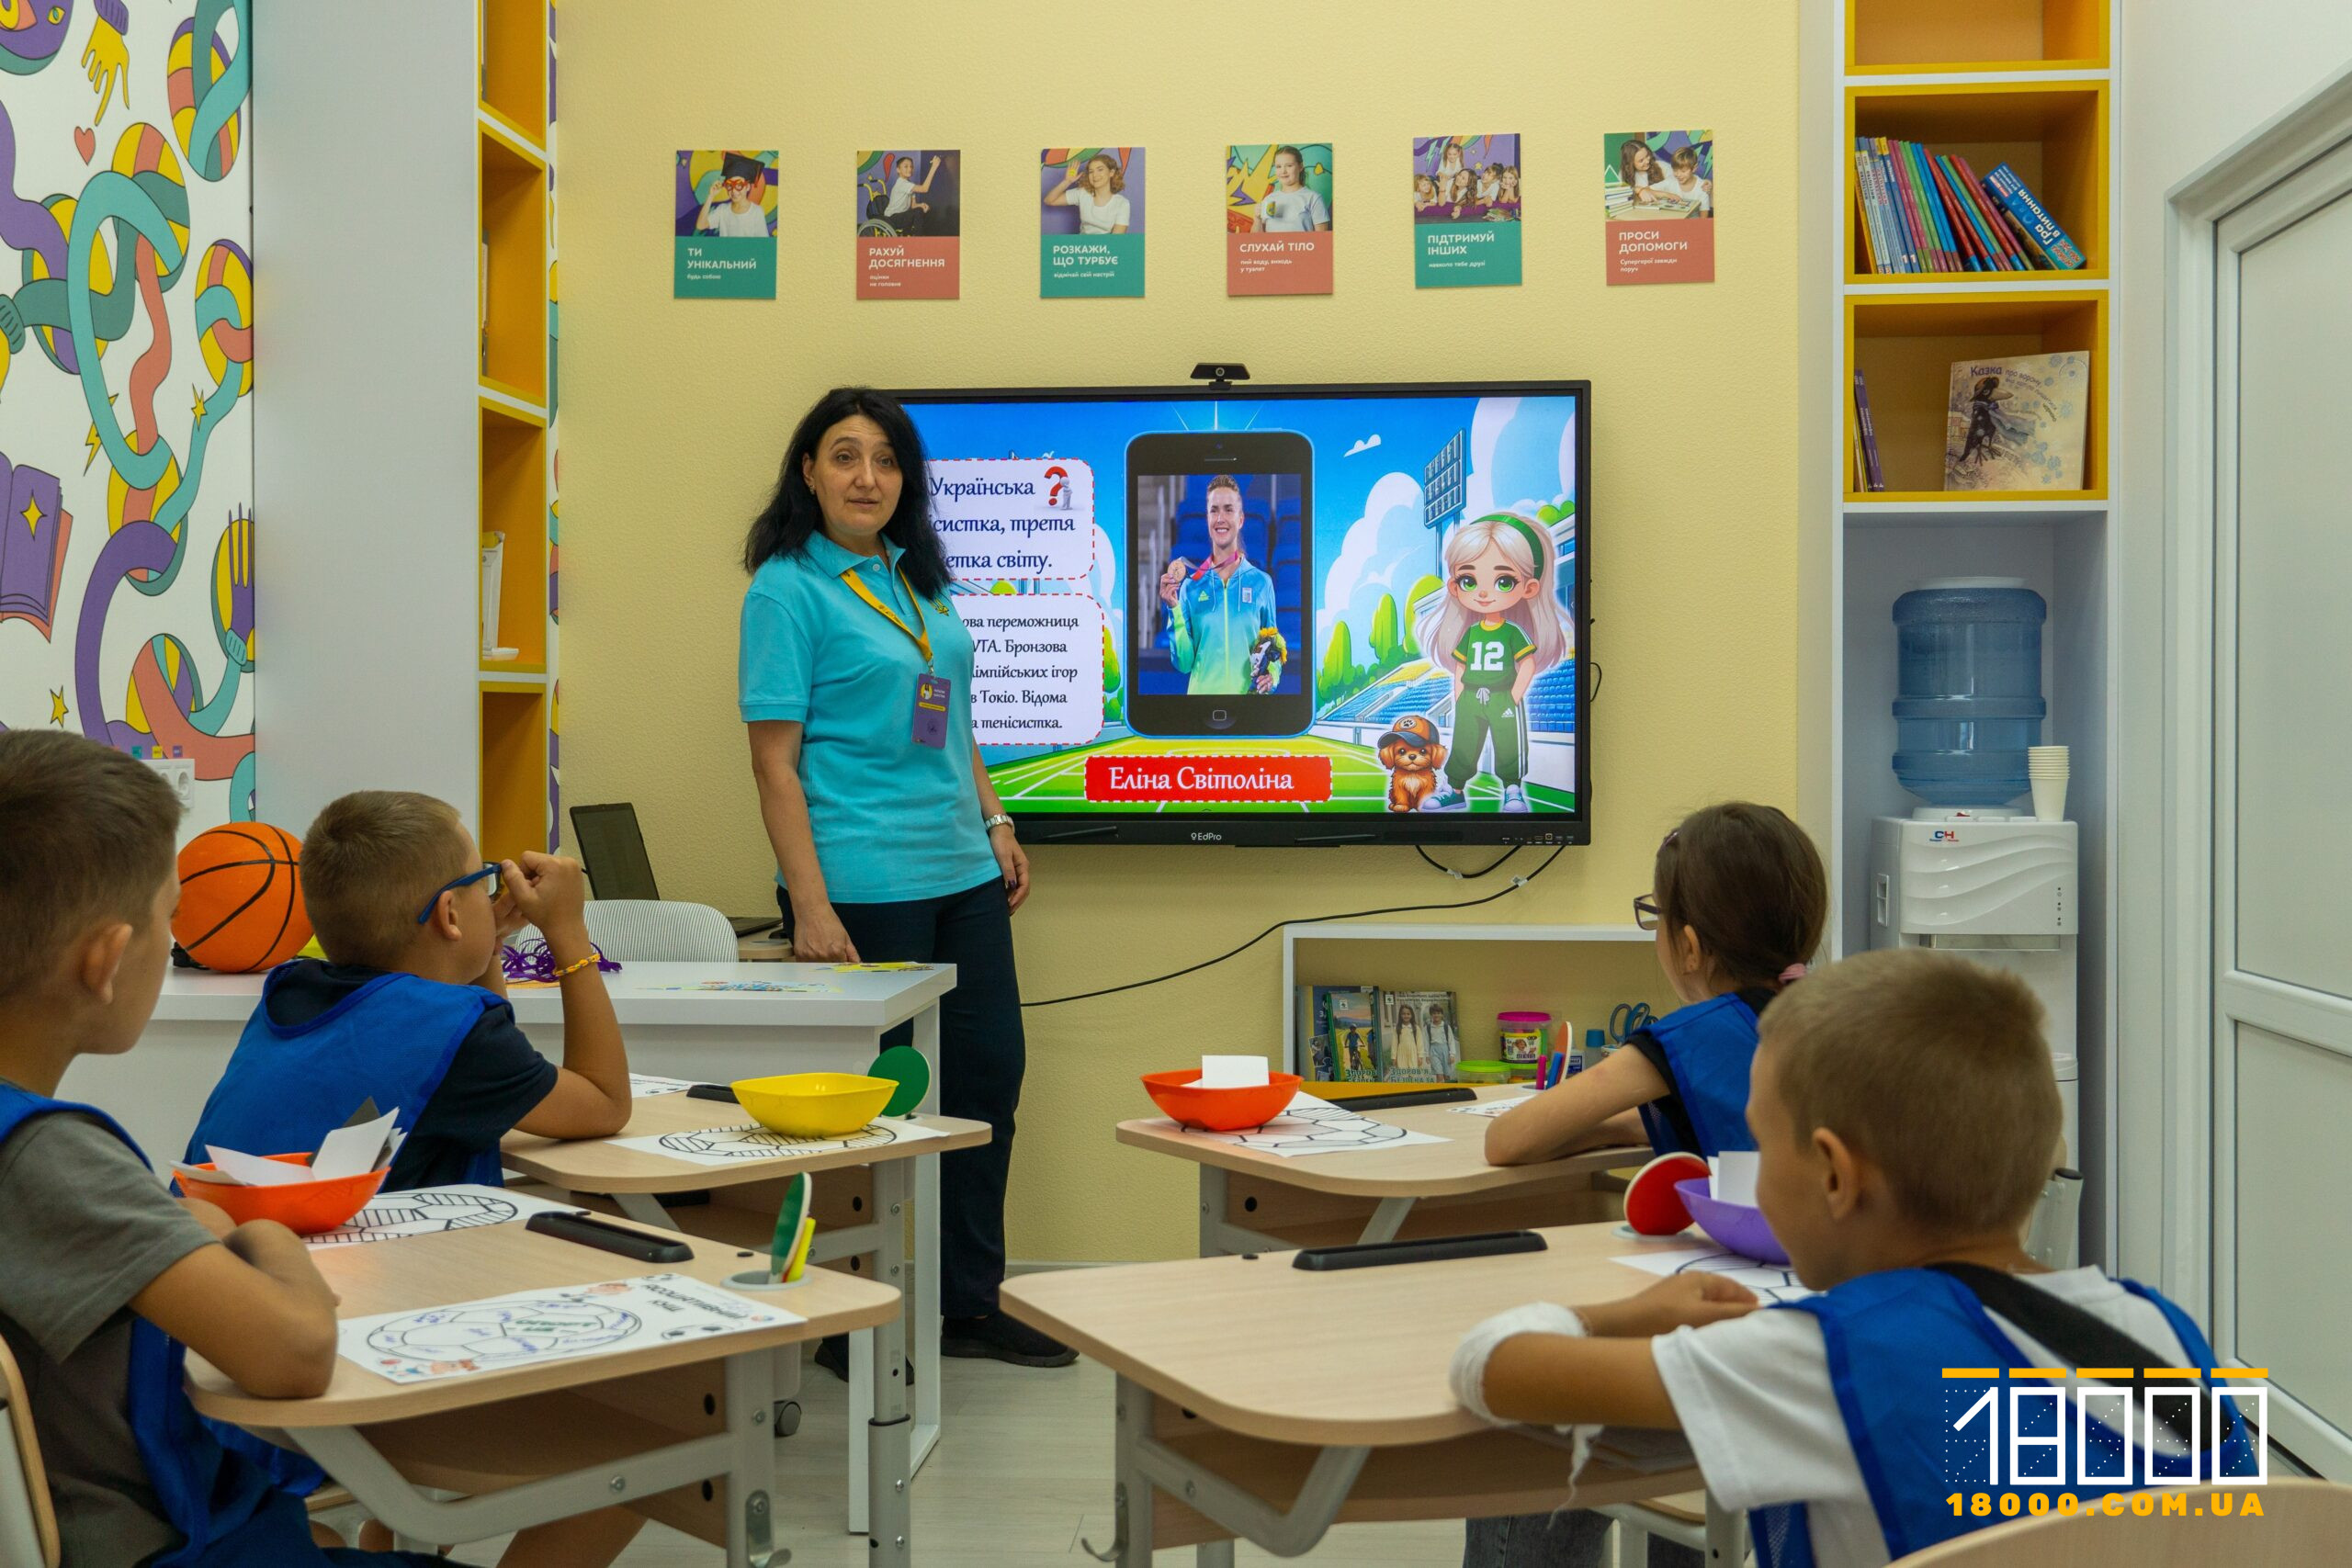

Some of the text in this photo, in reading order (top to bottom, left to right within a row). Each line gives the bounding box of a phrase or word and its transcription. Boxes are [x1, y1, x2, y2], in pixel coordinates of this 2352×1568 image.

[2018, 189, 2058, 231] питання
[1428, 231, 1495, 245] ПІДТРИМУЙ
[1619, 231, 1659, 242] ПРОСИ
[2034, 224, 2053, 246] Гра
[687, 248, 702, 256] ТИ
[869, 244, 904, 256] РАХУЙ
[1053, 245, 1110, 255] РОЗКАЖИ,
[1239, 242, 1315, 253] СЛУХАЙ ТІЛО
[1428, 245, 1467, 255] ІНШИХ
[1619, 242, 1688, 254] ДОПОМОГИ
[687, 257, 757, 269] УНІКАЛЬНИЙ
[869, 258, 945, 269] ДОСЯГНЕННЯ
[1053, 256, 1119, 266] ЩО ТУРБУЄ
[1970, 366, 2003, 378] Казка
[930, 477, 1035, 502] Українська
[933, 517, 1076, 537] систка, третя
[946, 549, 1052, 574] етка світу.
[963, 617, 1080, 632] ова переможниця
[1005, 639, 1068, 658] Бронзова
[1470, 641, 1504, 671] 12
[1051, 665, 1078, 682] ігор
[980, 690, 1019, 704] Токіо.
[1022, 690, 1069, 707] Відома
[982, 716, 1062, 728] тенісистка.
[1109, 766, 1295, 790] Еліна Світоліна
[1197, 832, 1222, 841] EdPro
[1934, 830, 1954, 839] CH
